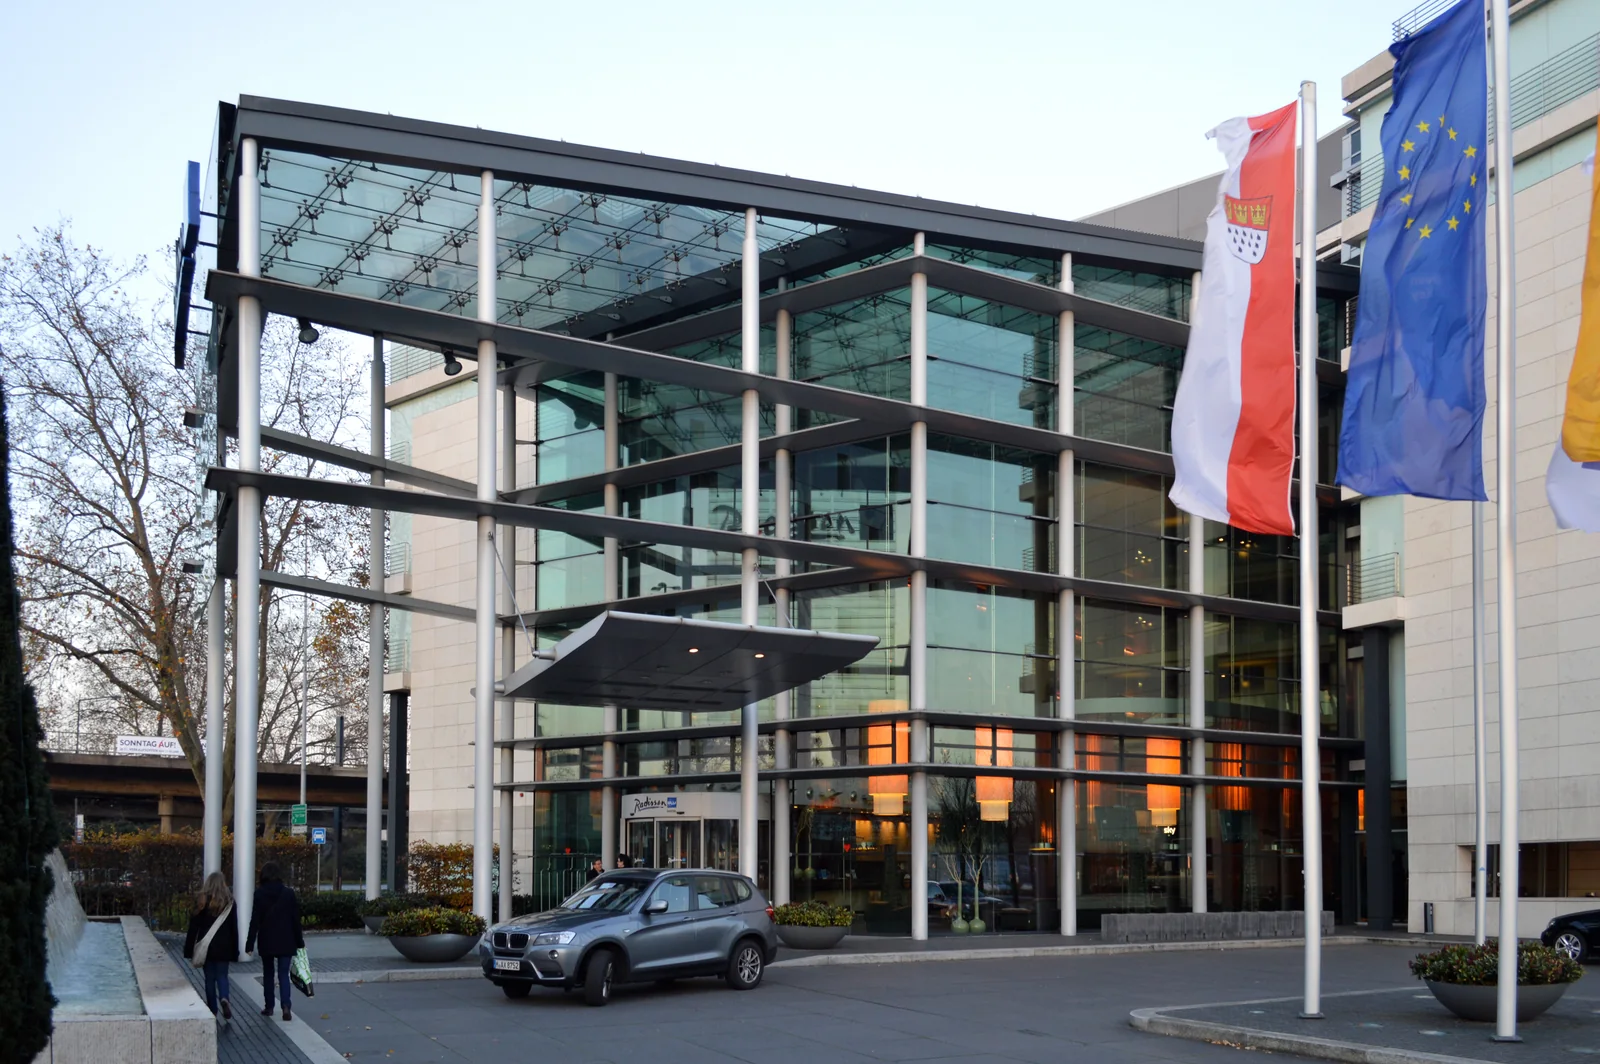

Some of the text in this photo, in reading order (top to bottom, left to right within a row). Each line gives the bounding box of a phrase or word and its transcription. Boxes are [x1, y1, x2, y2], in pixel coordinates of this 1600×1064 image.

[120, 739, 157, 748] SONNTAG
[634, 796, 667, 813] Radisson
[1163, 826, 1176, 835] sky
